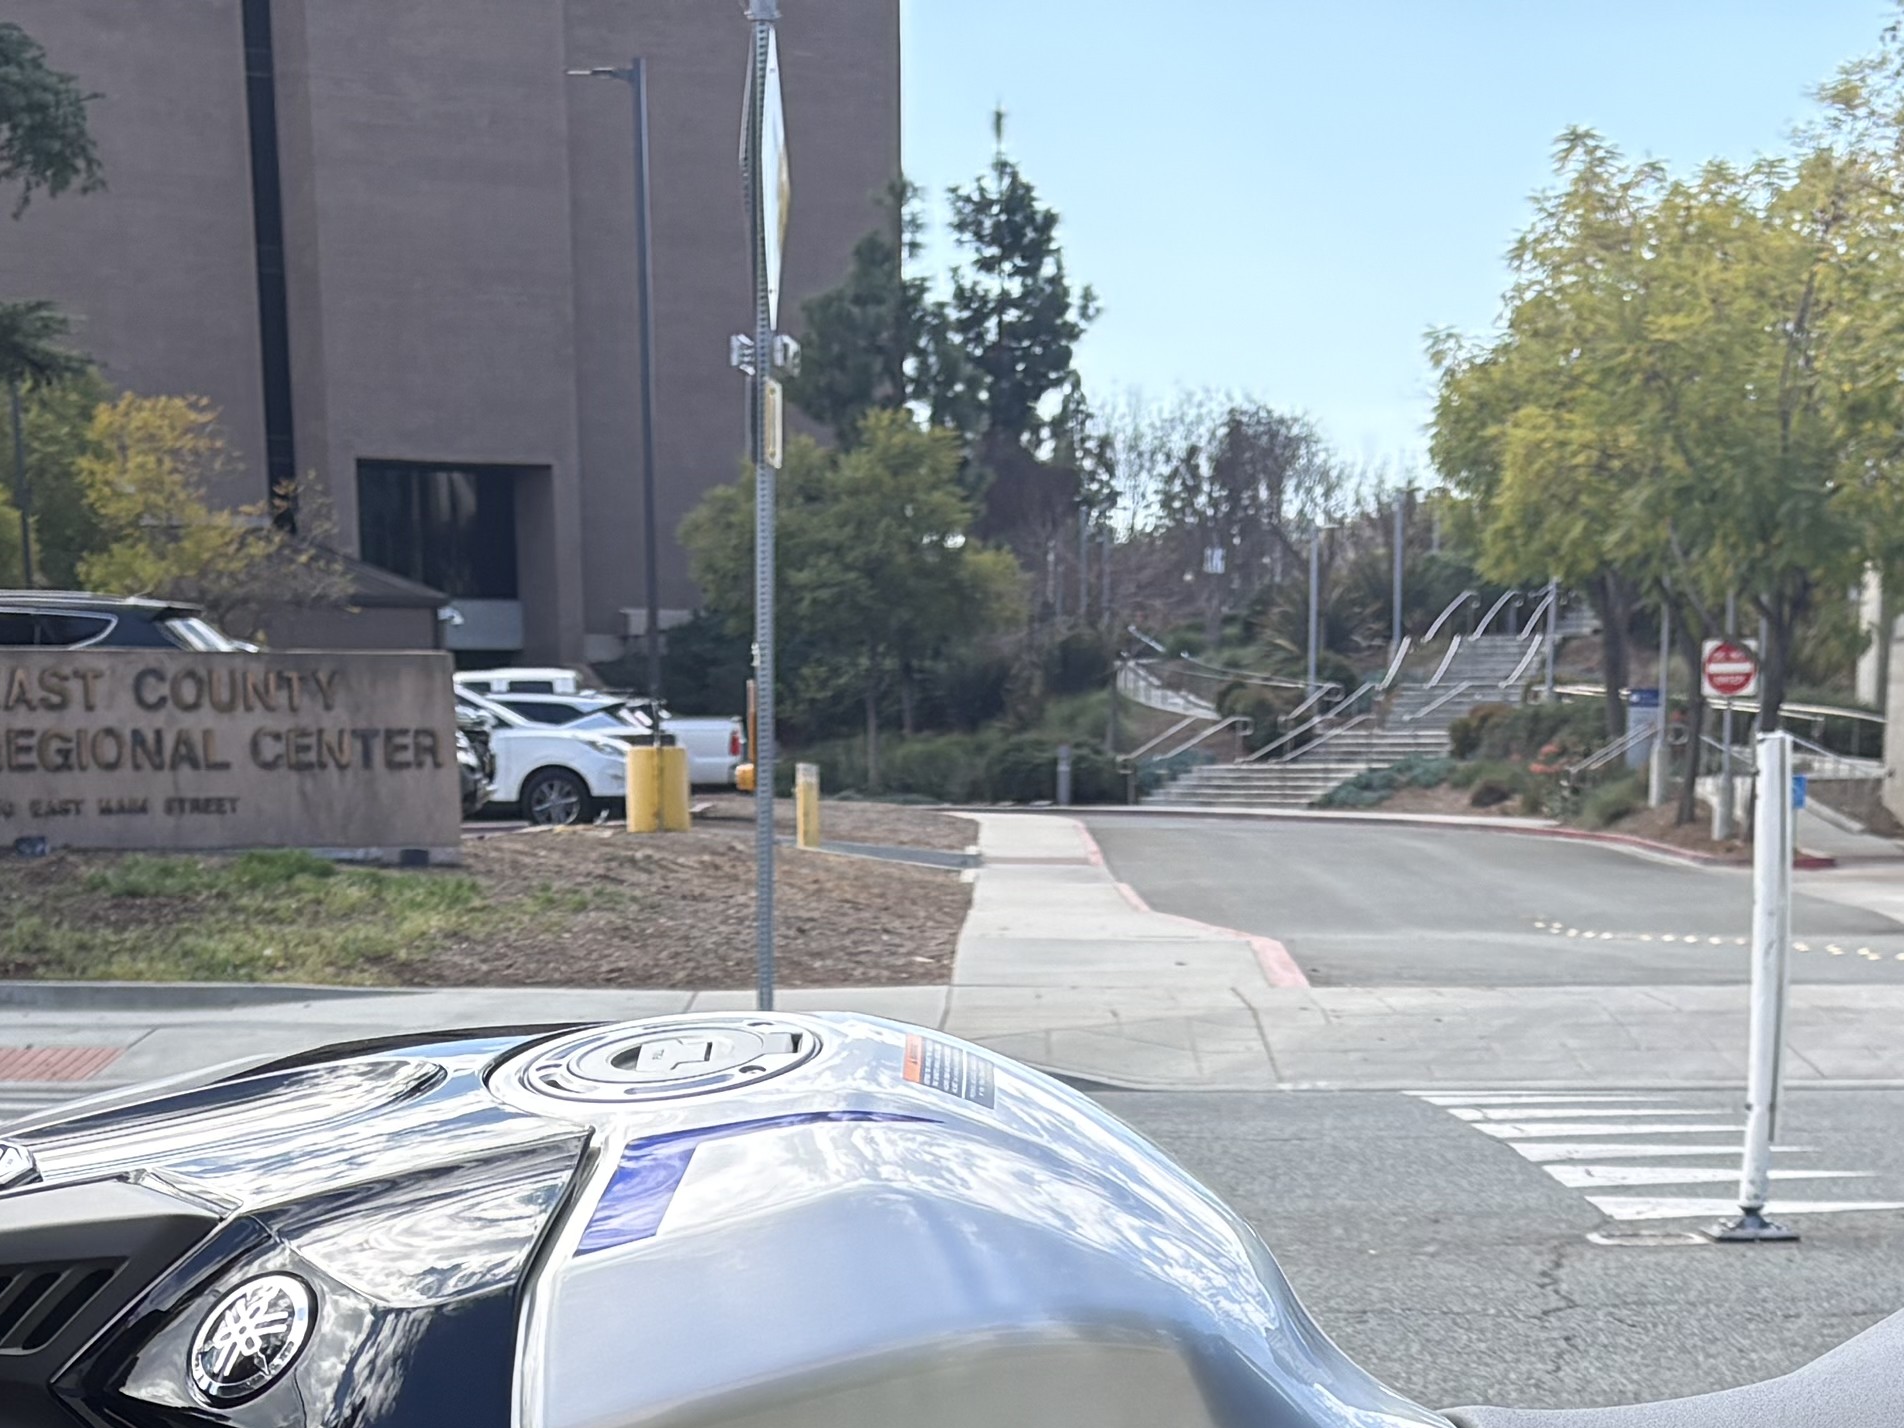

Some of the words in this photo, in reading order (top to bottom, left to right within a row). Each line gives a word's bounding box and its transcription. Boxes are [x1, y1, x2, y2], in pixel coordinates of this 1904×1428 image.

[132, 666, 341, 714] COUNTY
[250, 726, 445, 772] CENTER
[28, 798, 85, 819] EAST
[163, 796, 241, 817] STREET
